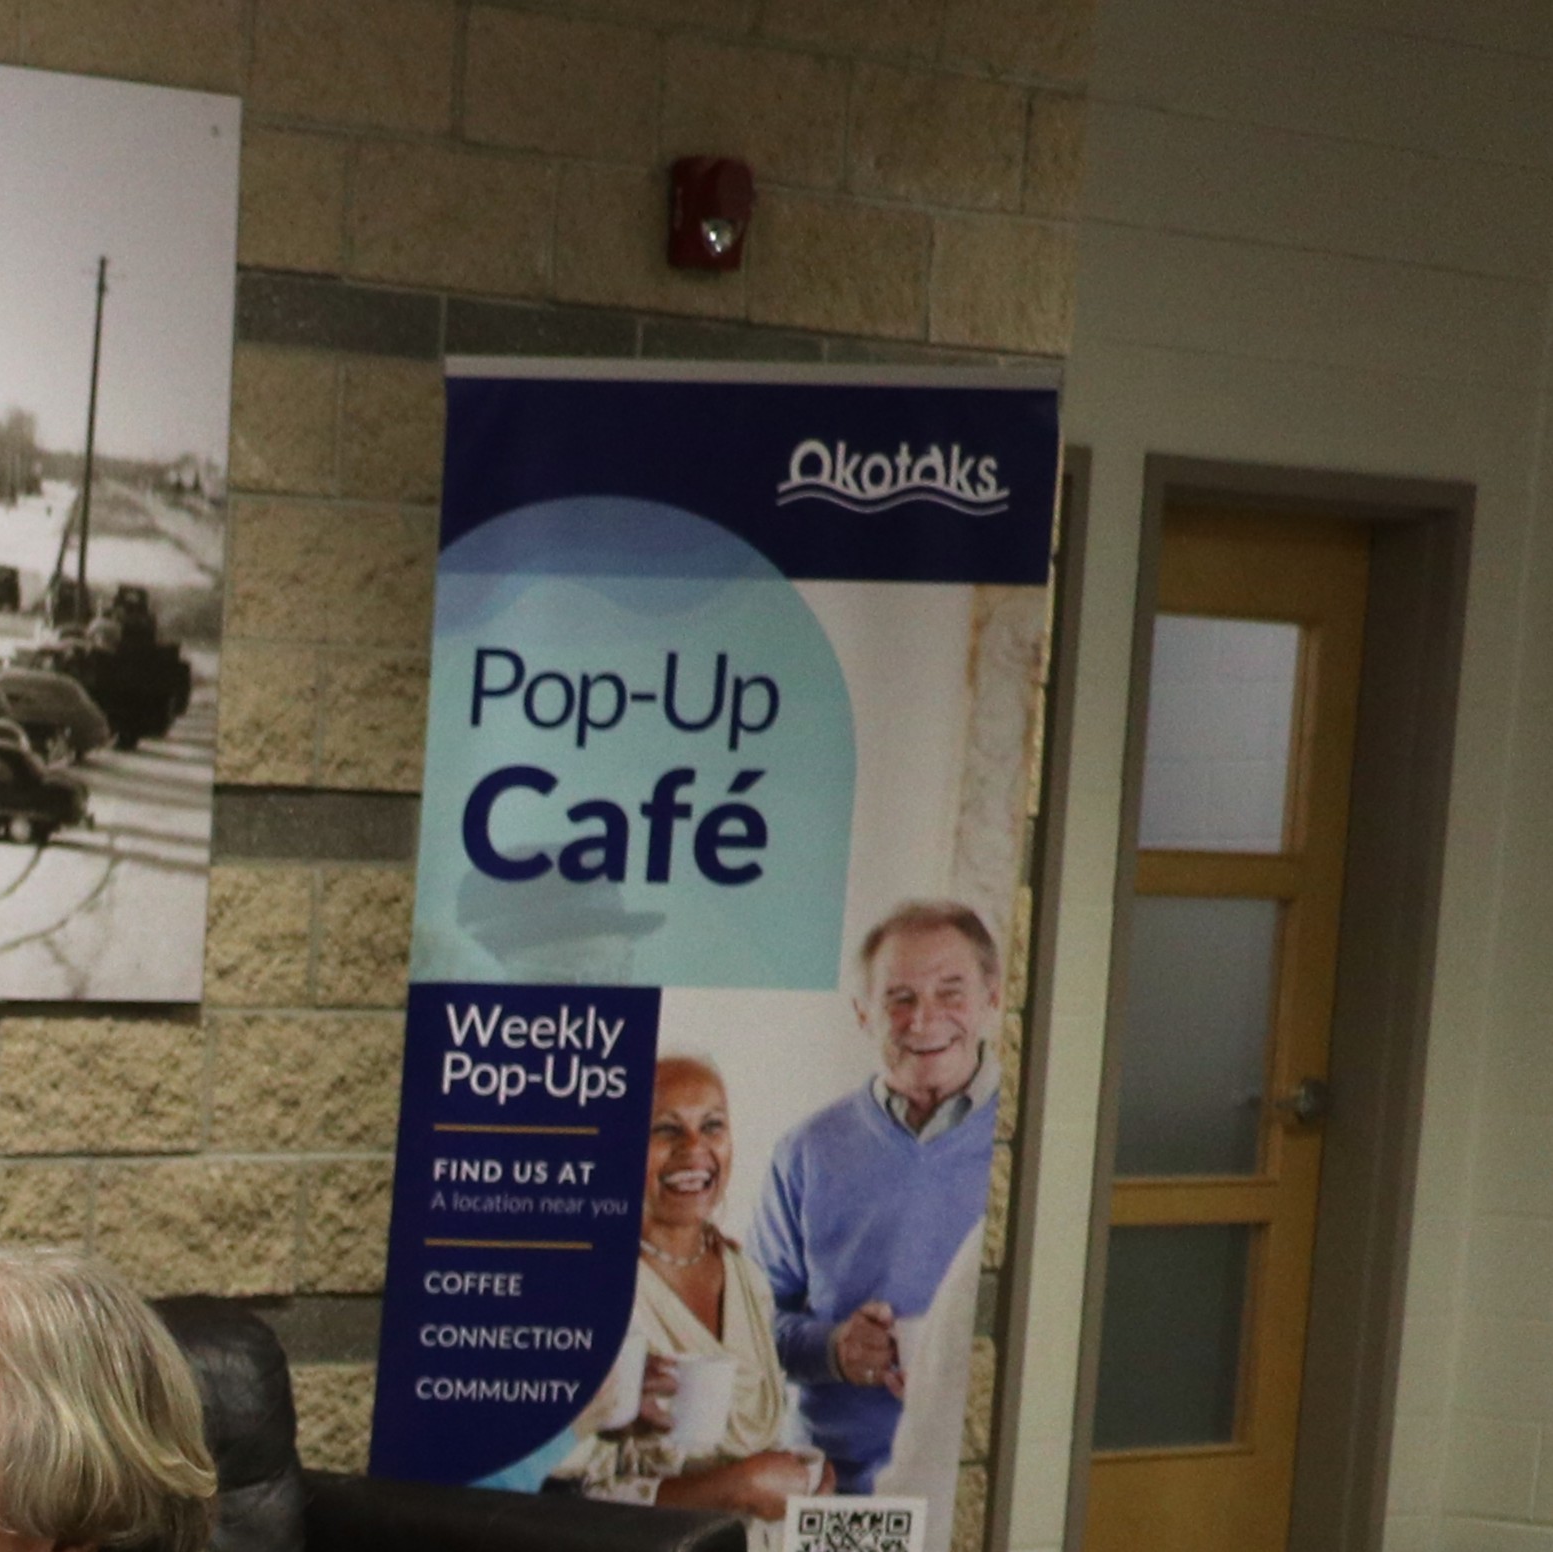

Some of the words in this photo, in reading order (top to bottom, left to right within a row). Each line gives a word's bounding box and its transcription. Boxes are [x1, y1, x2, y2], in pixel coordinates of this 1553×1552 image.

[470, 648, 780, 751] Pop-Up
[462, 765, 769, 886] Café
[446, 1003, 625, 1059] Weekly
[442, 1051, 627, 1106] Pop-Ups
[433, 1158, 503, 1183] FIND
[512, 1160, 548, 1184] US
[557, 1161, 596, 1185] AT
[431, 1192, 446, 1210] A
[452, 1192, 533, 1213] location
[540, 1196, 584, 1214] near
[592, 1199, 629, 1218] you
[423, 1270, 524, 1297] COFFEE
[419, 1323, 594, 1350] CONNECTION
[415, 1376, 581, 1403] COMMUNITY
